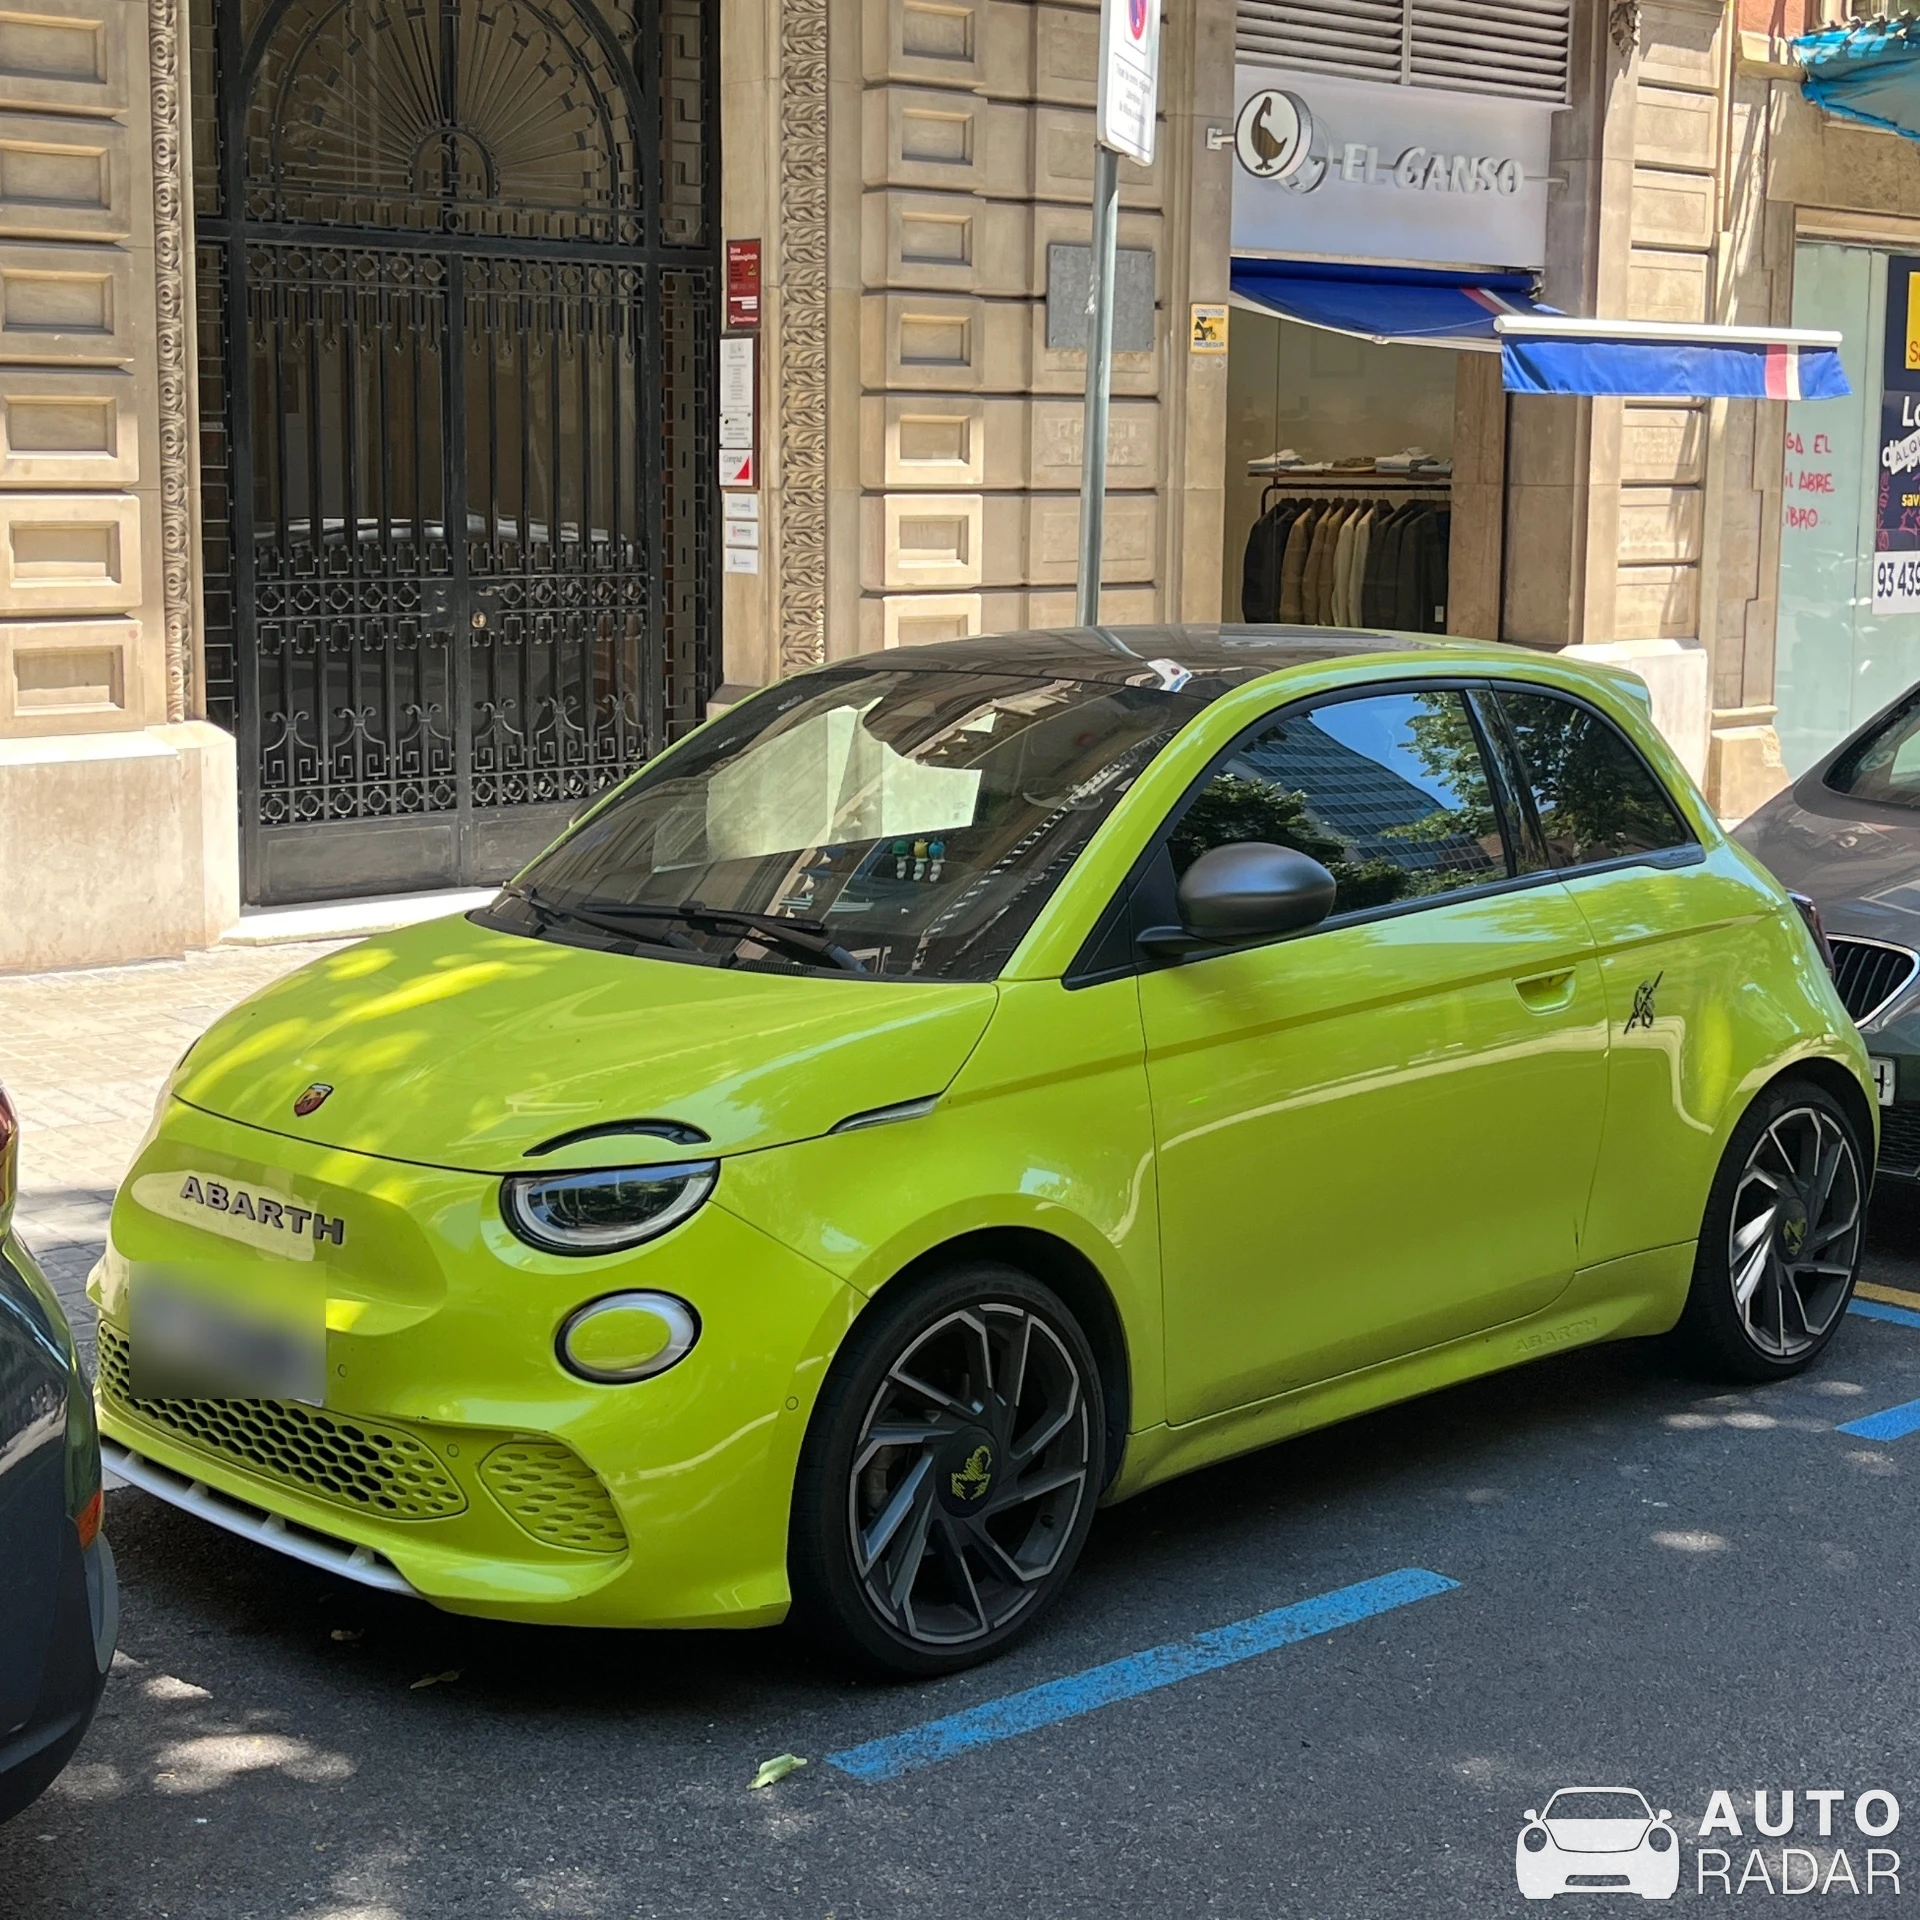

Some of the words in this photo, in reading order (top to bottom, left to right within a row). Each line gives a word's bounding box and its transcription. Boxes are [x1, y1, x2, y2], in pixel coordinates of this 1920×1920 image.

[1341, 143, 1386, 185] EL
[1394, 145, 1525, 198] GANSO
[1813, 433, 1832, 454] EL
[1799, 469, 1835, 494] ABRE
[1877, 561, 1895, 599] 93
[179, 1175, 345, 1246] ABARTH
